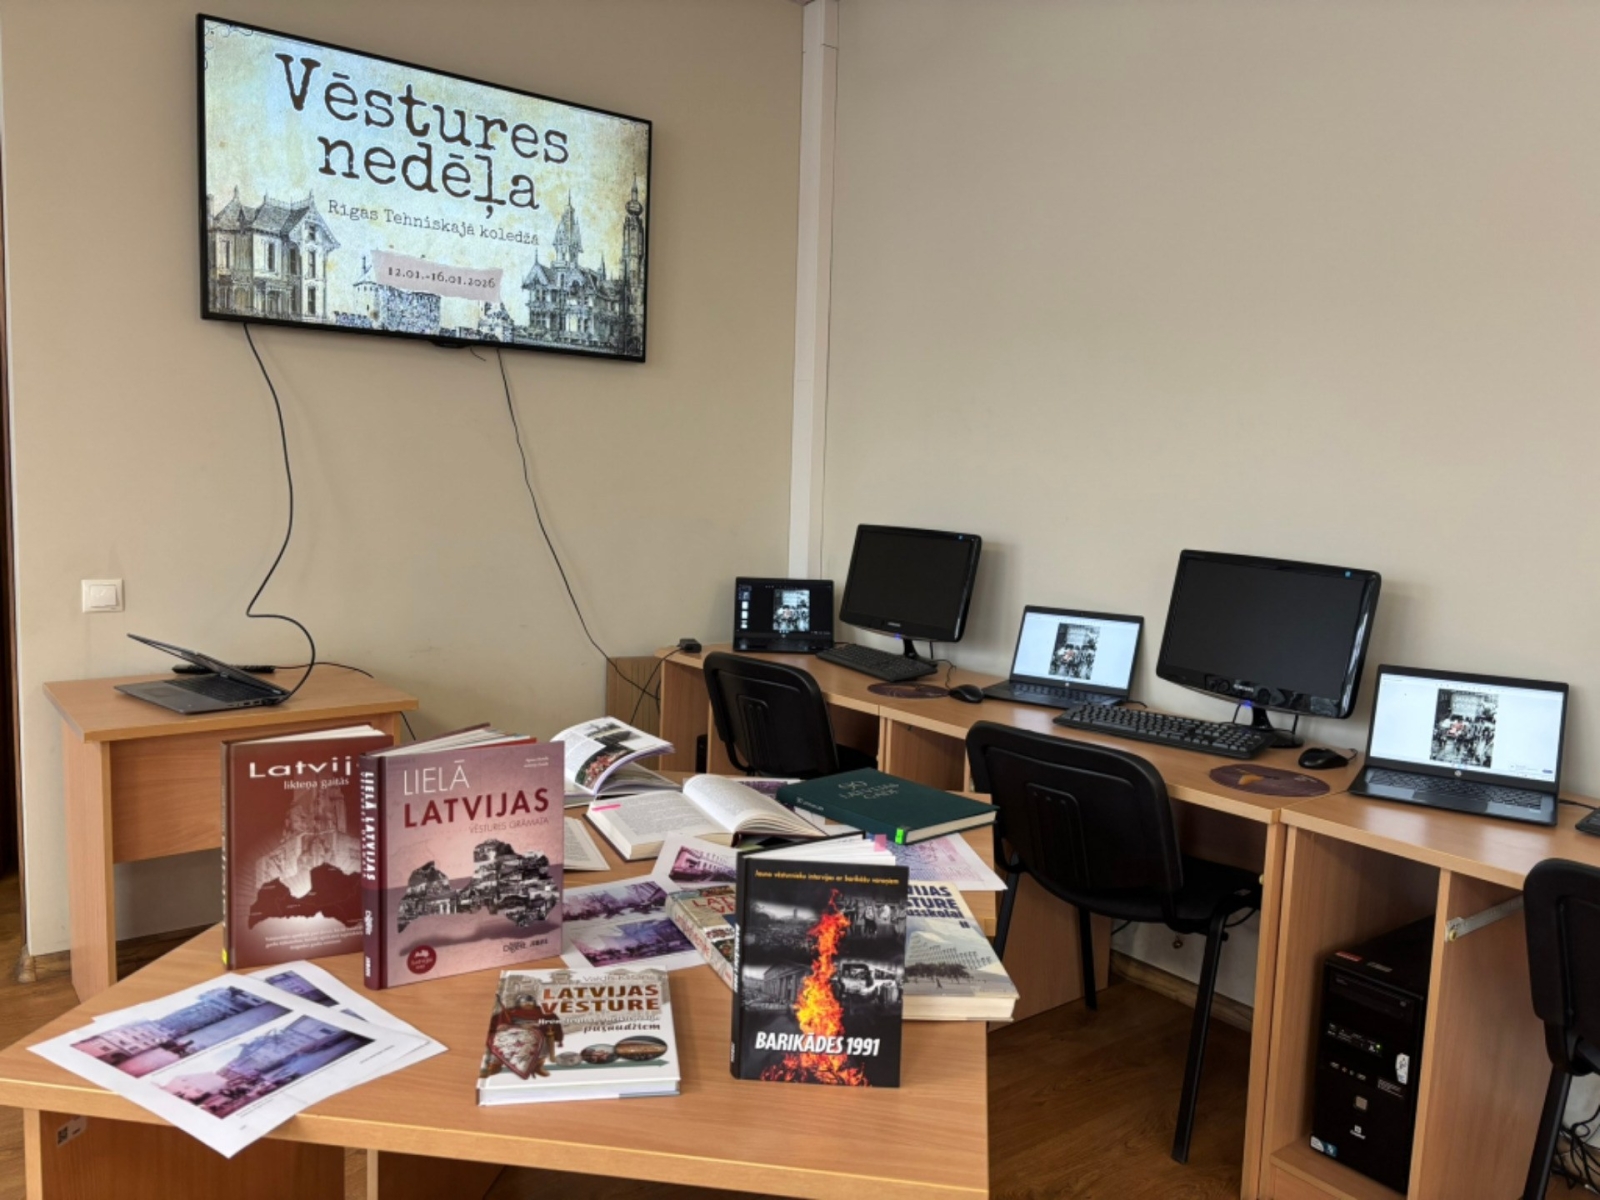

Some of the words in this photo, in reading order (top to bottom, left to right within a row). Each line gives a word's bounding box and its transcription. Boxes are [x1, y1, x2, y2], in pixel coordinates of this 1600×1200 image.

[275, 53, 570, 165] Vēstures
[317, 136, 540, 218] nedēļa
[388, 266, 496, 289] 12.01.-16.01.2026
[249, 755, 359, 778] Latvij
[404, 759, 470, 796] LIELĀ
[404, 787, 549, 828] LATVIJAS
[365, 816, 376, 881] LATVIJAS
[907, 885, 952, 897] VIJAS
[543, 984, 659, 1001] LATVIJAS
[755, 1031, 844, 1055] BARIKĀDES
[846, 1036, 880, 1058] 1991
